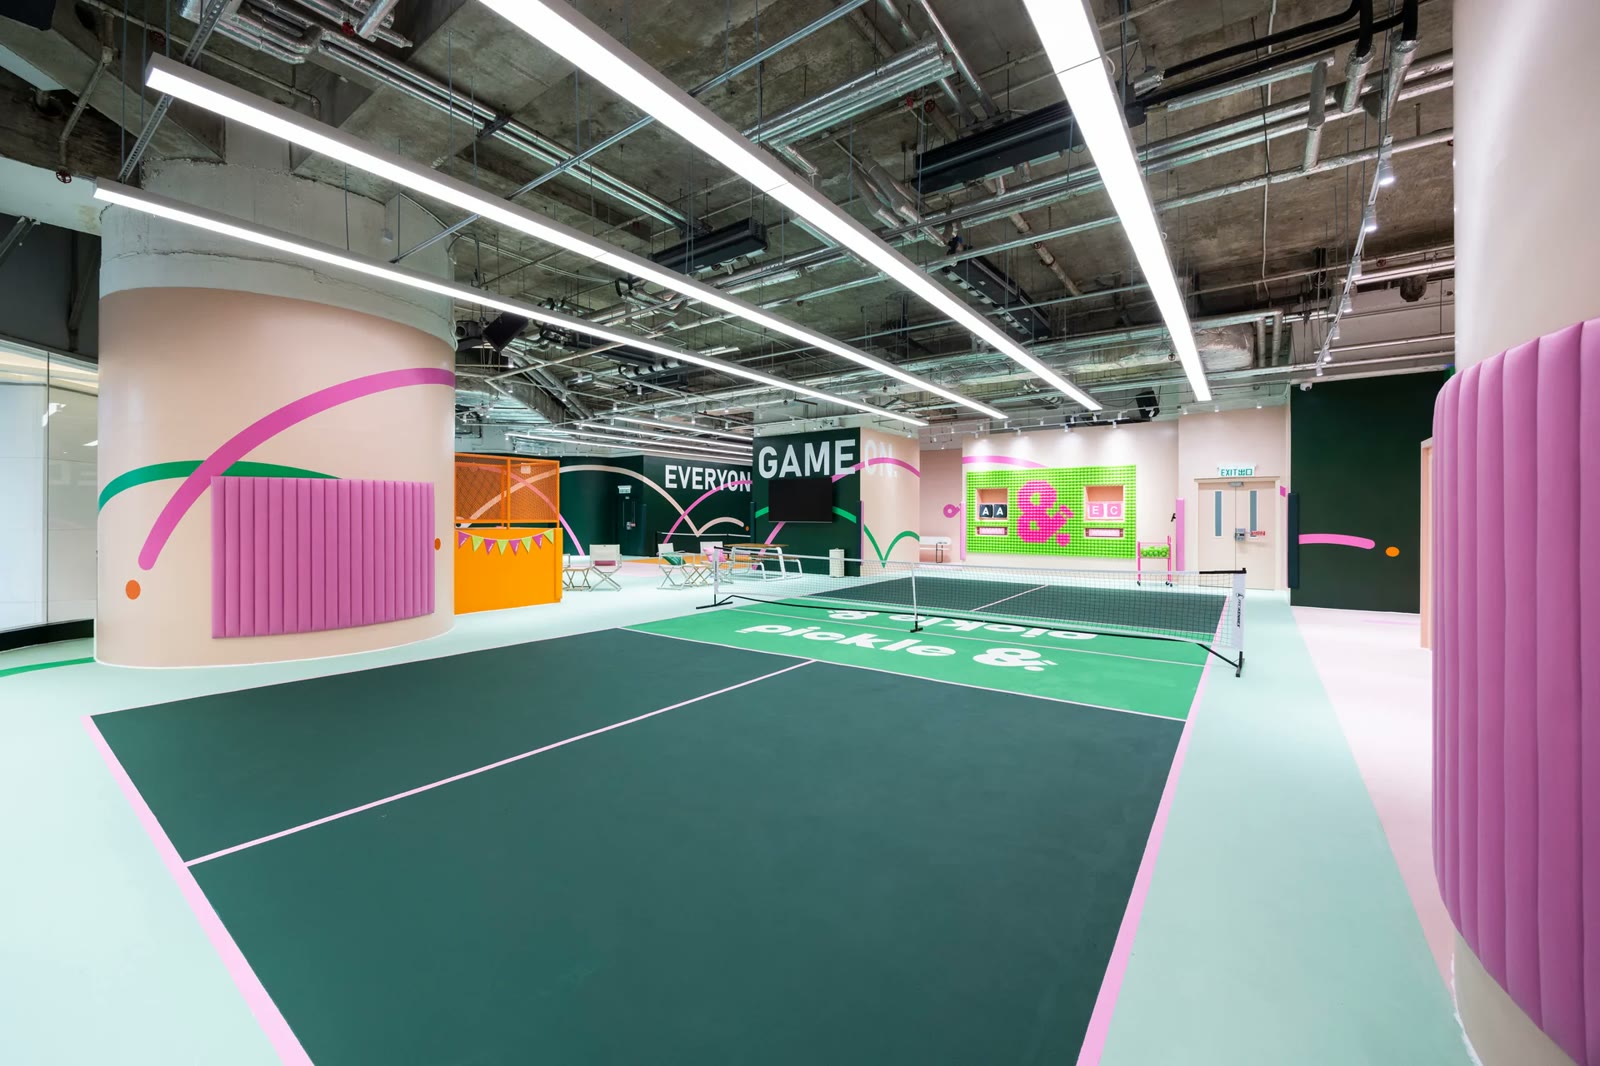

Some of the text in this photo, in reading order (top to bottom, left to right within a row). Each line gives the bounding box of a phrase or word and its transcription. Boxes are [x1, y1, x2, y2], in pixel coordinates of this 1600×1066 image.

[758, 439, 856, 479] GAME
[1220, 468, 1253, 477] EXIT 出口
[665, 464, 751, 492] EVERYON
[735, 625, 956, 656] pickle
